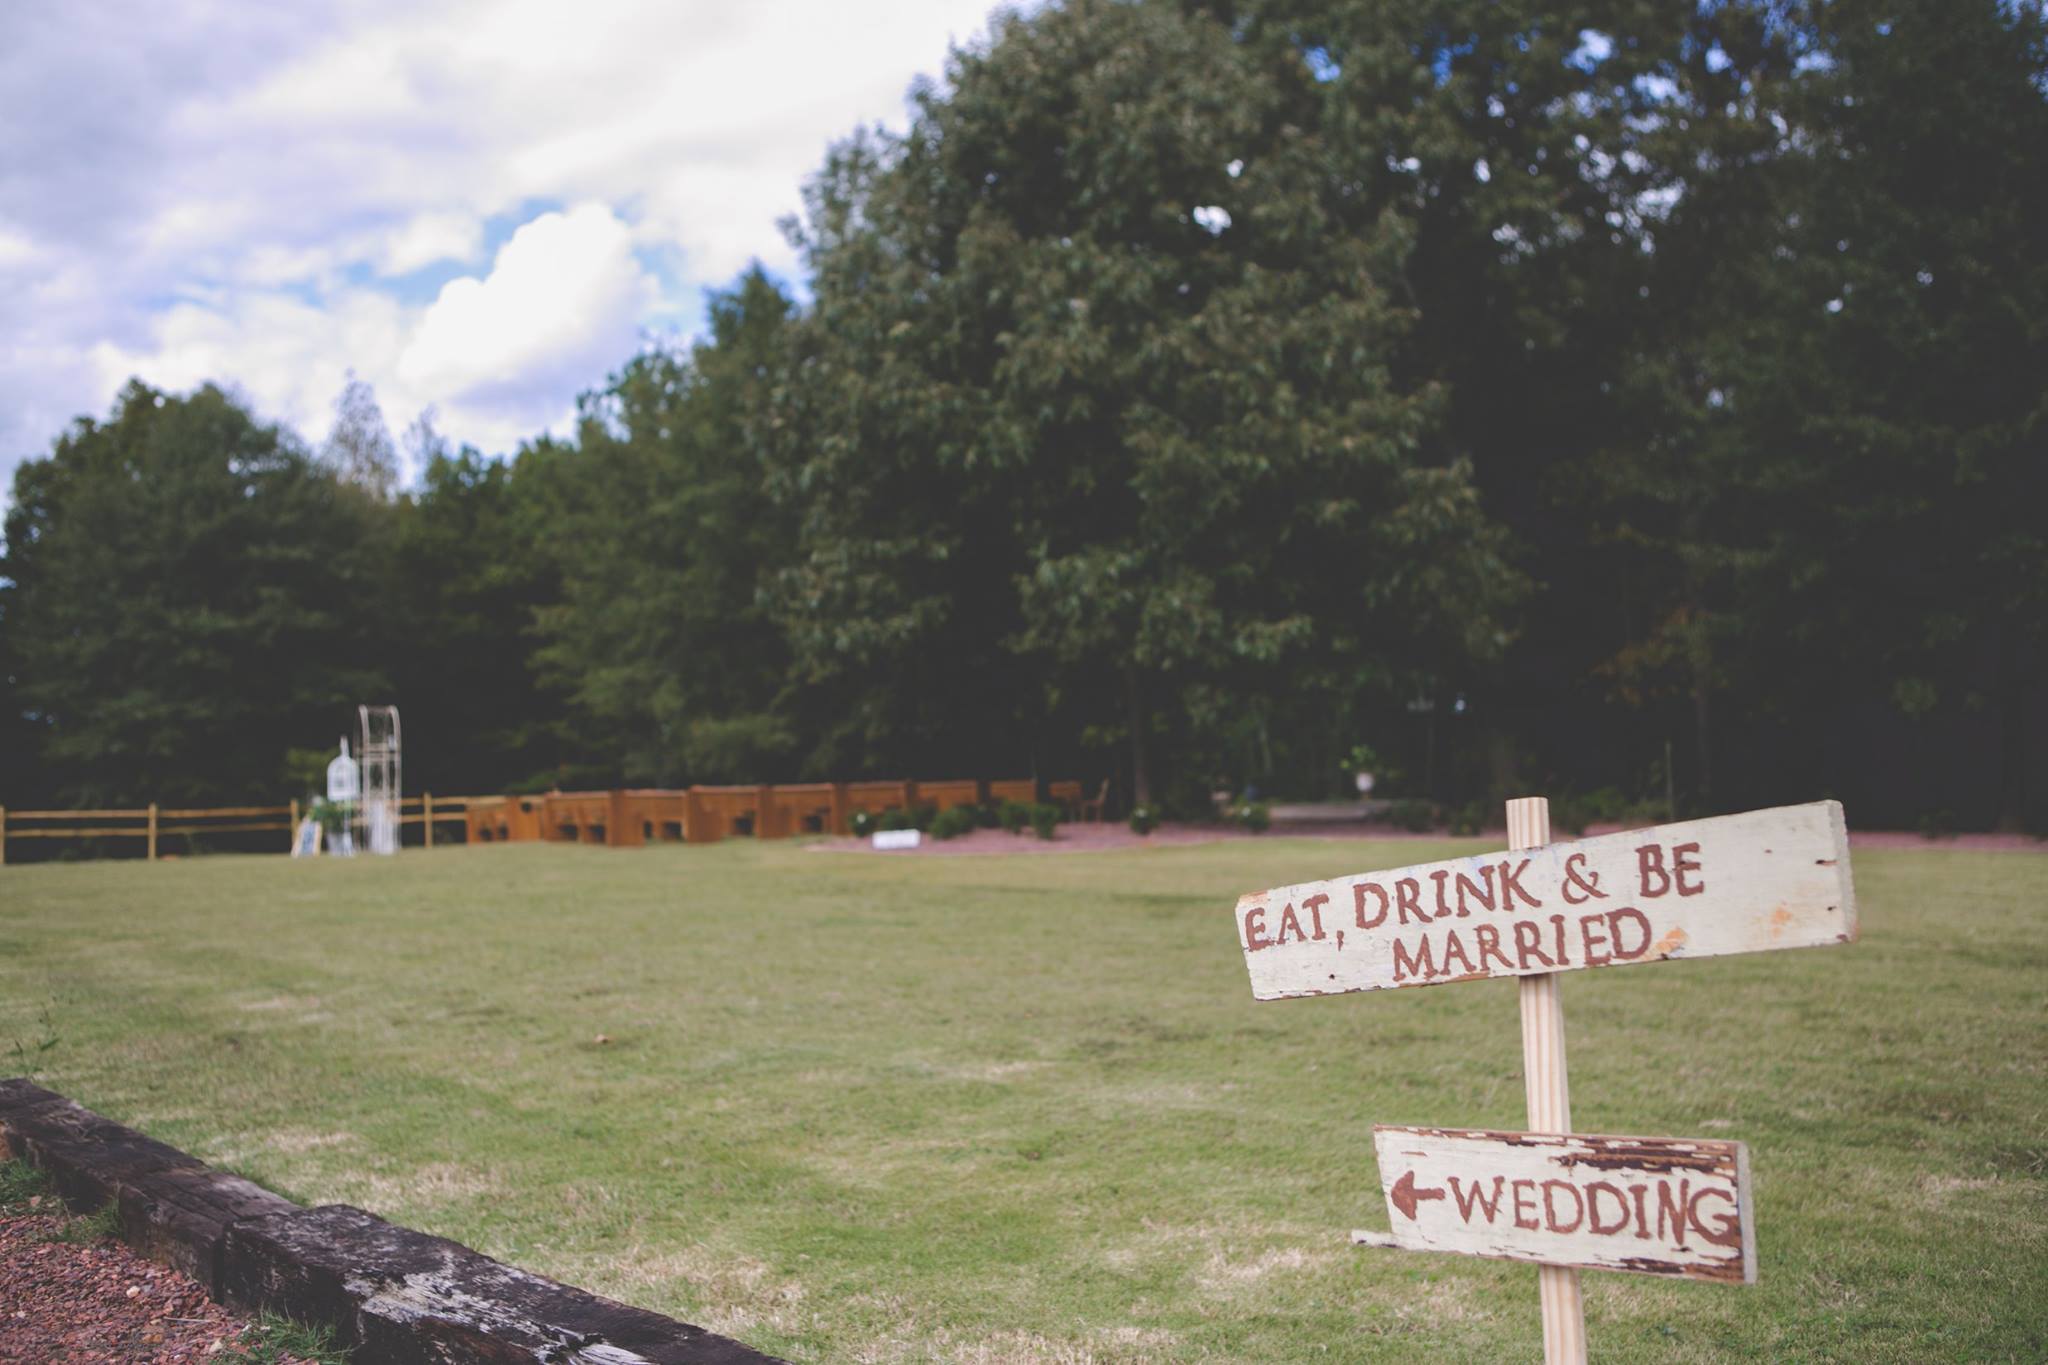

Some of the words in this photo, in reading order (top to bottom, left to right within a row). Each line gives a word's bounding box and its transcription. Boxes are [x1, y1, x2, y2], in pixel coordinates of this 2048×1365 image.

[1245, 894, 1344, 951] EAT,
[1353, 858, 1542, 930] DRINK
[1561, 852, 1609, 904] &
[1635, 842, 1704, 899] BE
[1392, 907, 1652, 982] MARRIED
[1447, 1175, 1740, 1247] WEDDING
